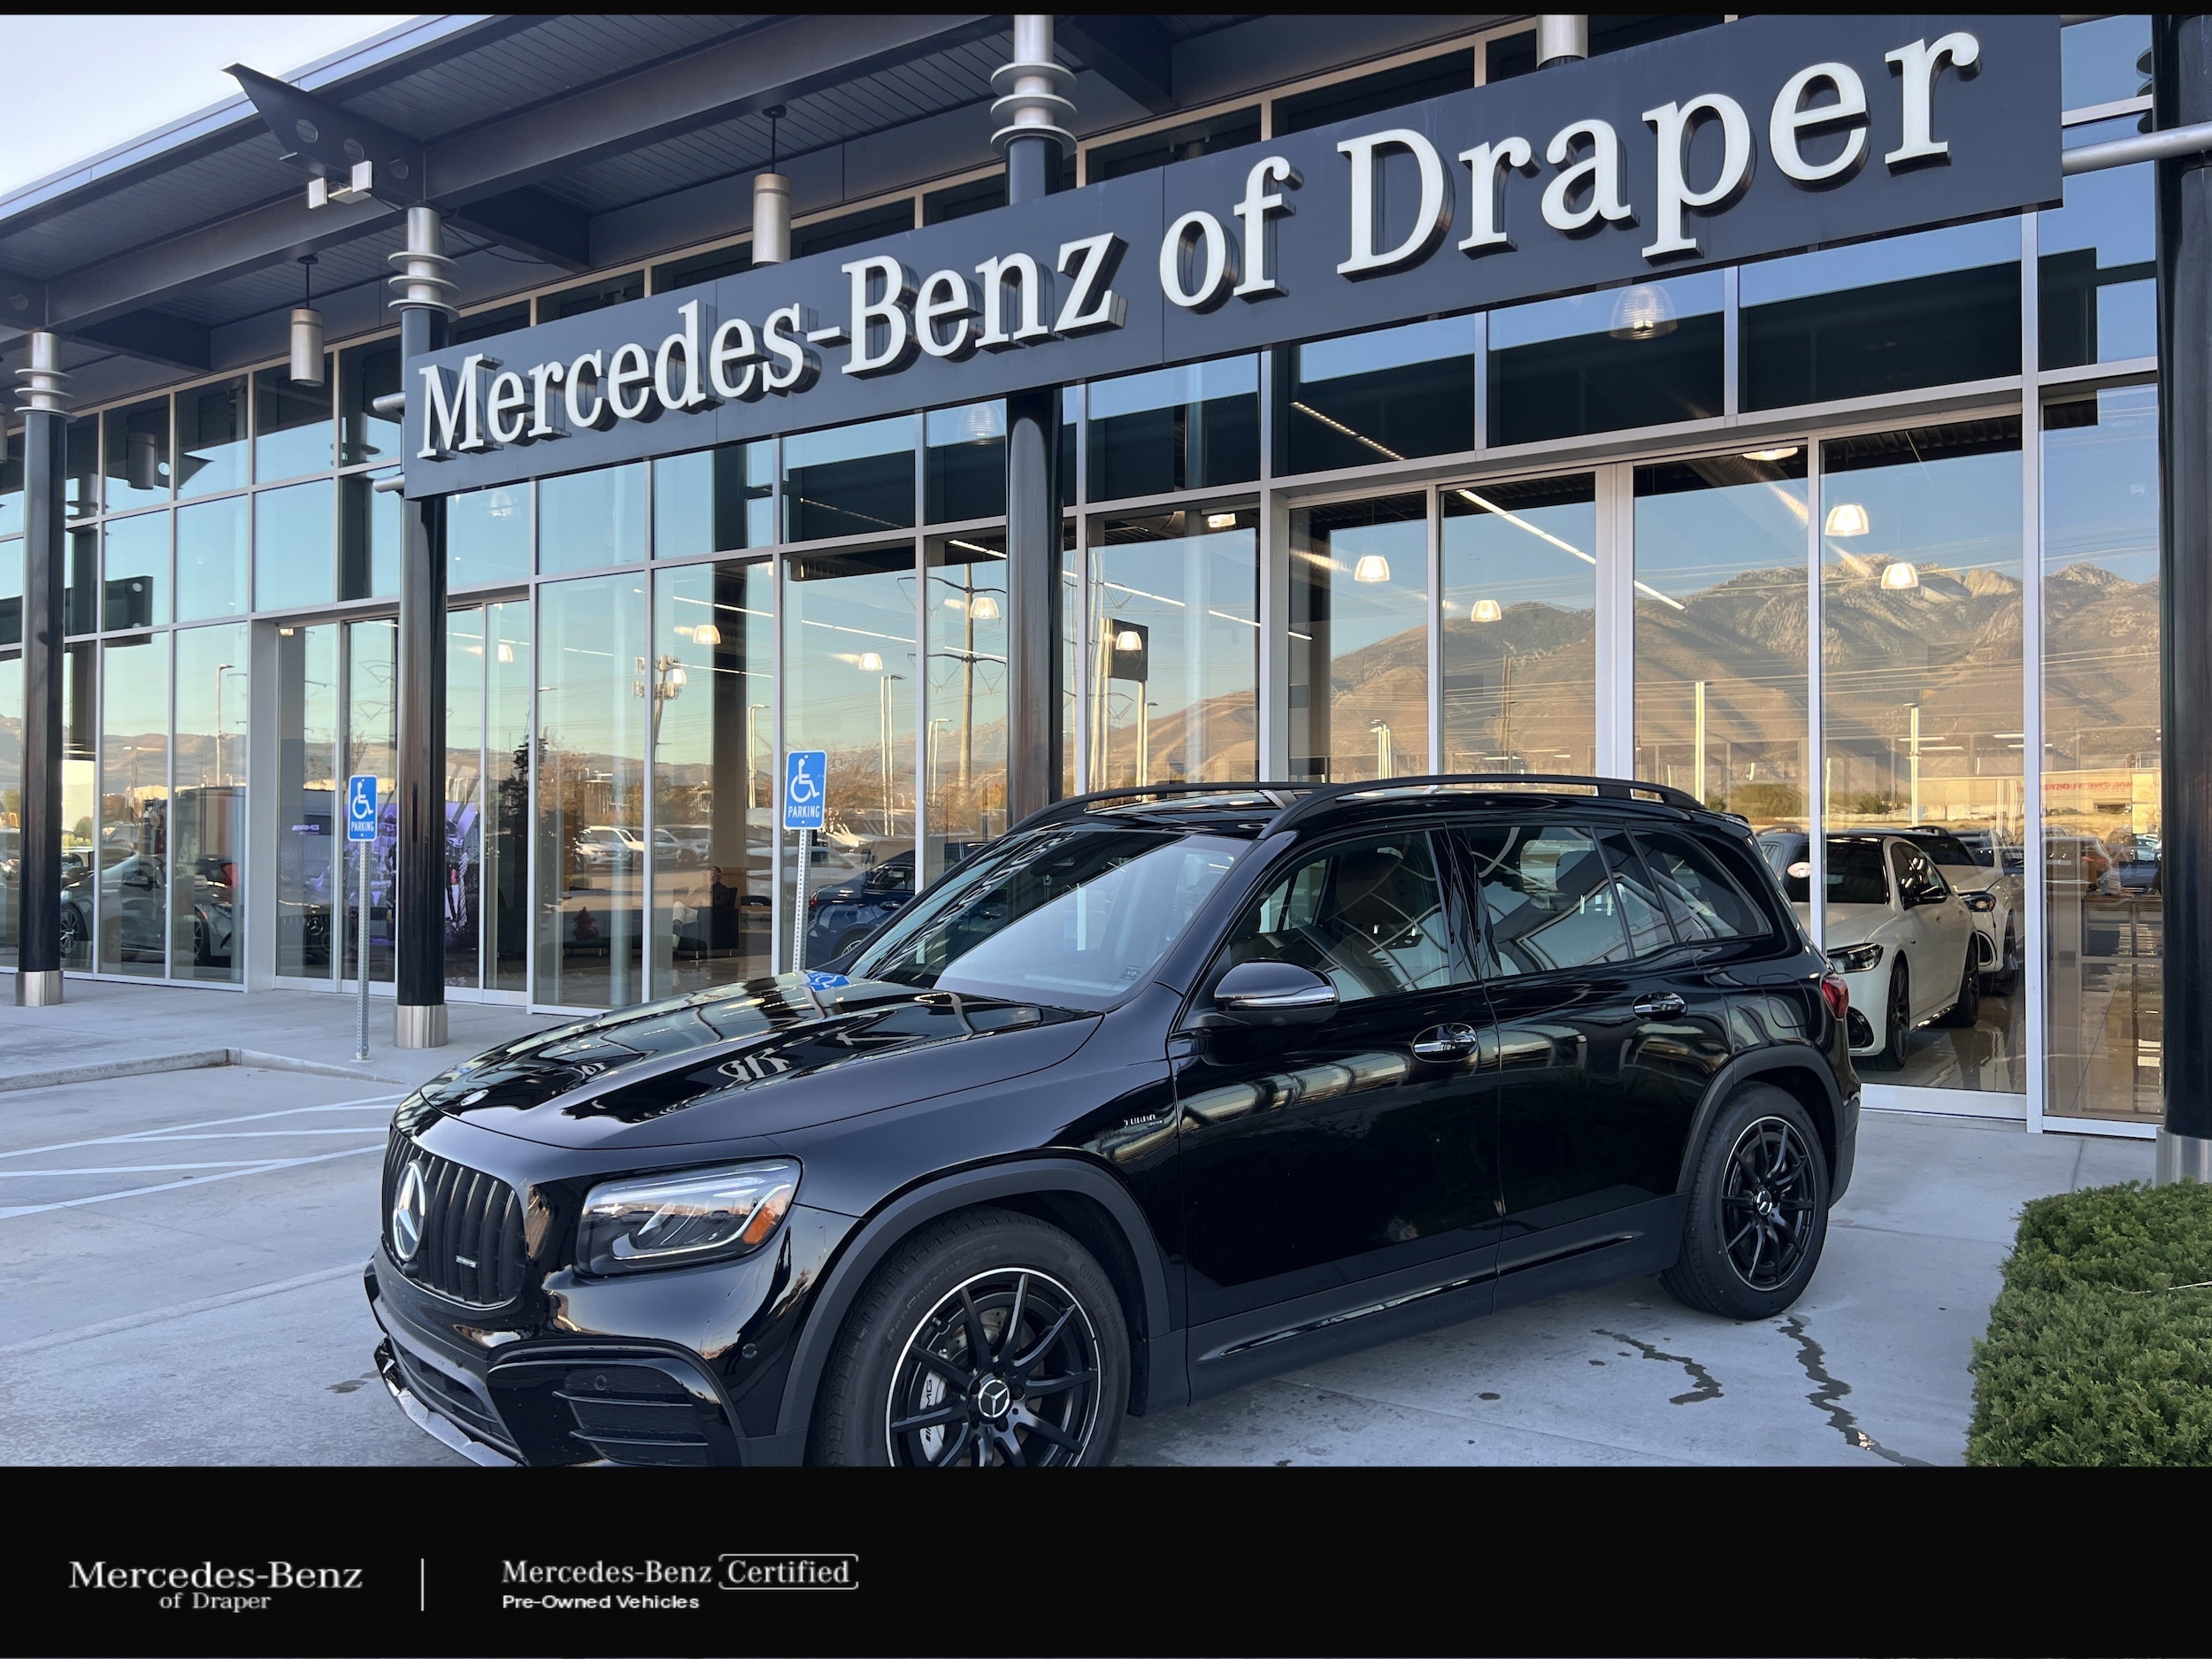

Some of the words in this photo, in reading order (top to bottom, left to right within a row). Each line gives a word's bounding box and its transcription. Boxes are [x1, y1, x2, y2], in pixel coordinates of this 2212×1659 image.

[417, 232, 1125, 461] Mercedes-Benz
[1158, 156, 1294, 310] of
[1336, 32, 1980, 274] Draper
[787, 805, 820, 818] PARKING
[350, 820, 374, 832] PARKING
